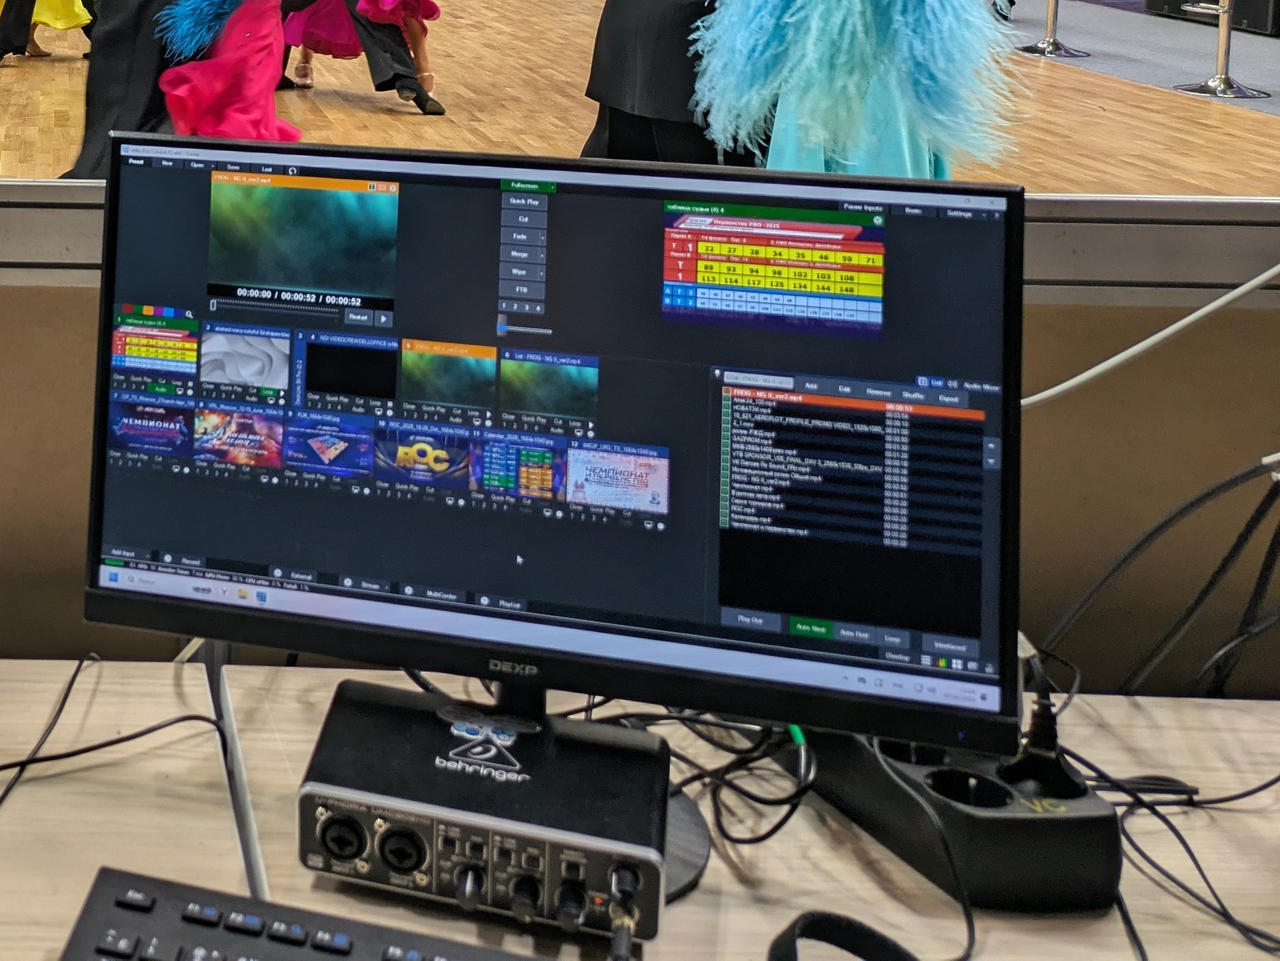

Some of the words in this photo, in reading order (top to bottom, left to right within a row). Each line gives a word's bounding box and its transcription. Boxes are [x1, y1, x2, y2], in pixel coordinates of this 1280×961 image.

[190, 161, 204, 169] Open
[510, 181, 539, 189] Fullscreen
[509, 197, 526, 205] Quick
[527, 198, 539, 206] Play
[843, 202, 863, 210] Pause
[864, 204, 883, 212] Inputs
[946, 210, 972, 218] Settings
[518, 215, 529, 223] Cut
[713, 219, 747, 227] Первенство
[841, 255, 853, 263] 59
[511, 268, 527, 276] Wipe
[749, 267, 759, 275] 94
[816, 272, 831, 280] 103
[701, 275, 716, 283] 113
[793, 282, 807, 290] 134
[236, 287, 272, 298] 00:00:00
[280, 291, 317, 303] 00:00:52
[325, 295, 361, 307] 00:00:52
[349, 312, 368, 321] Restart
[734, 388, 751, 397] FROG
[839, 385, 851, 393] Edit
[866, 388, 891, 396] Remove
[902, 391, 924, 400] Shuffle
[938, 395, 959, 403] Export
[396, 442, 450, 471] ROC
[586, 466, 651, 479] ЧЕМПИОНАТ
[796, 622, 812, 631] Auto
[489, 659, 538, 675] DEXP
[435, 756, 531, 782] behringer
[229, 912, 245, 923] F2
